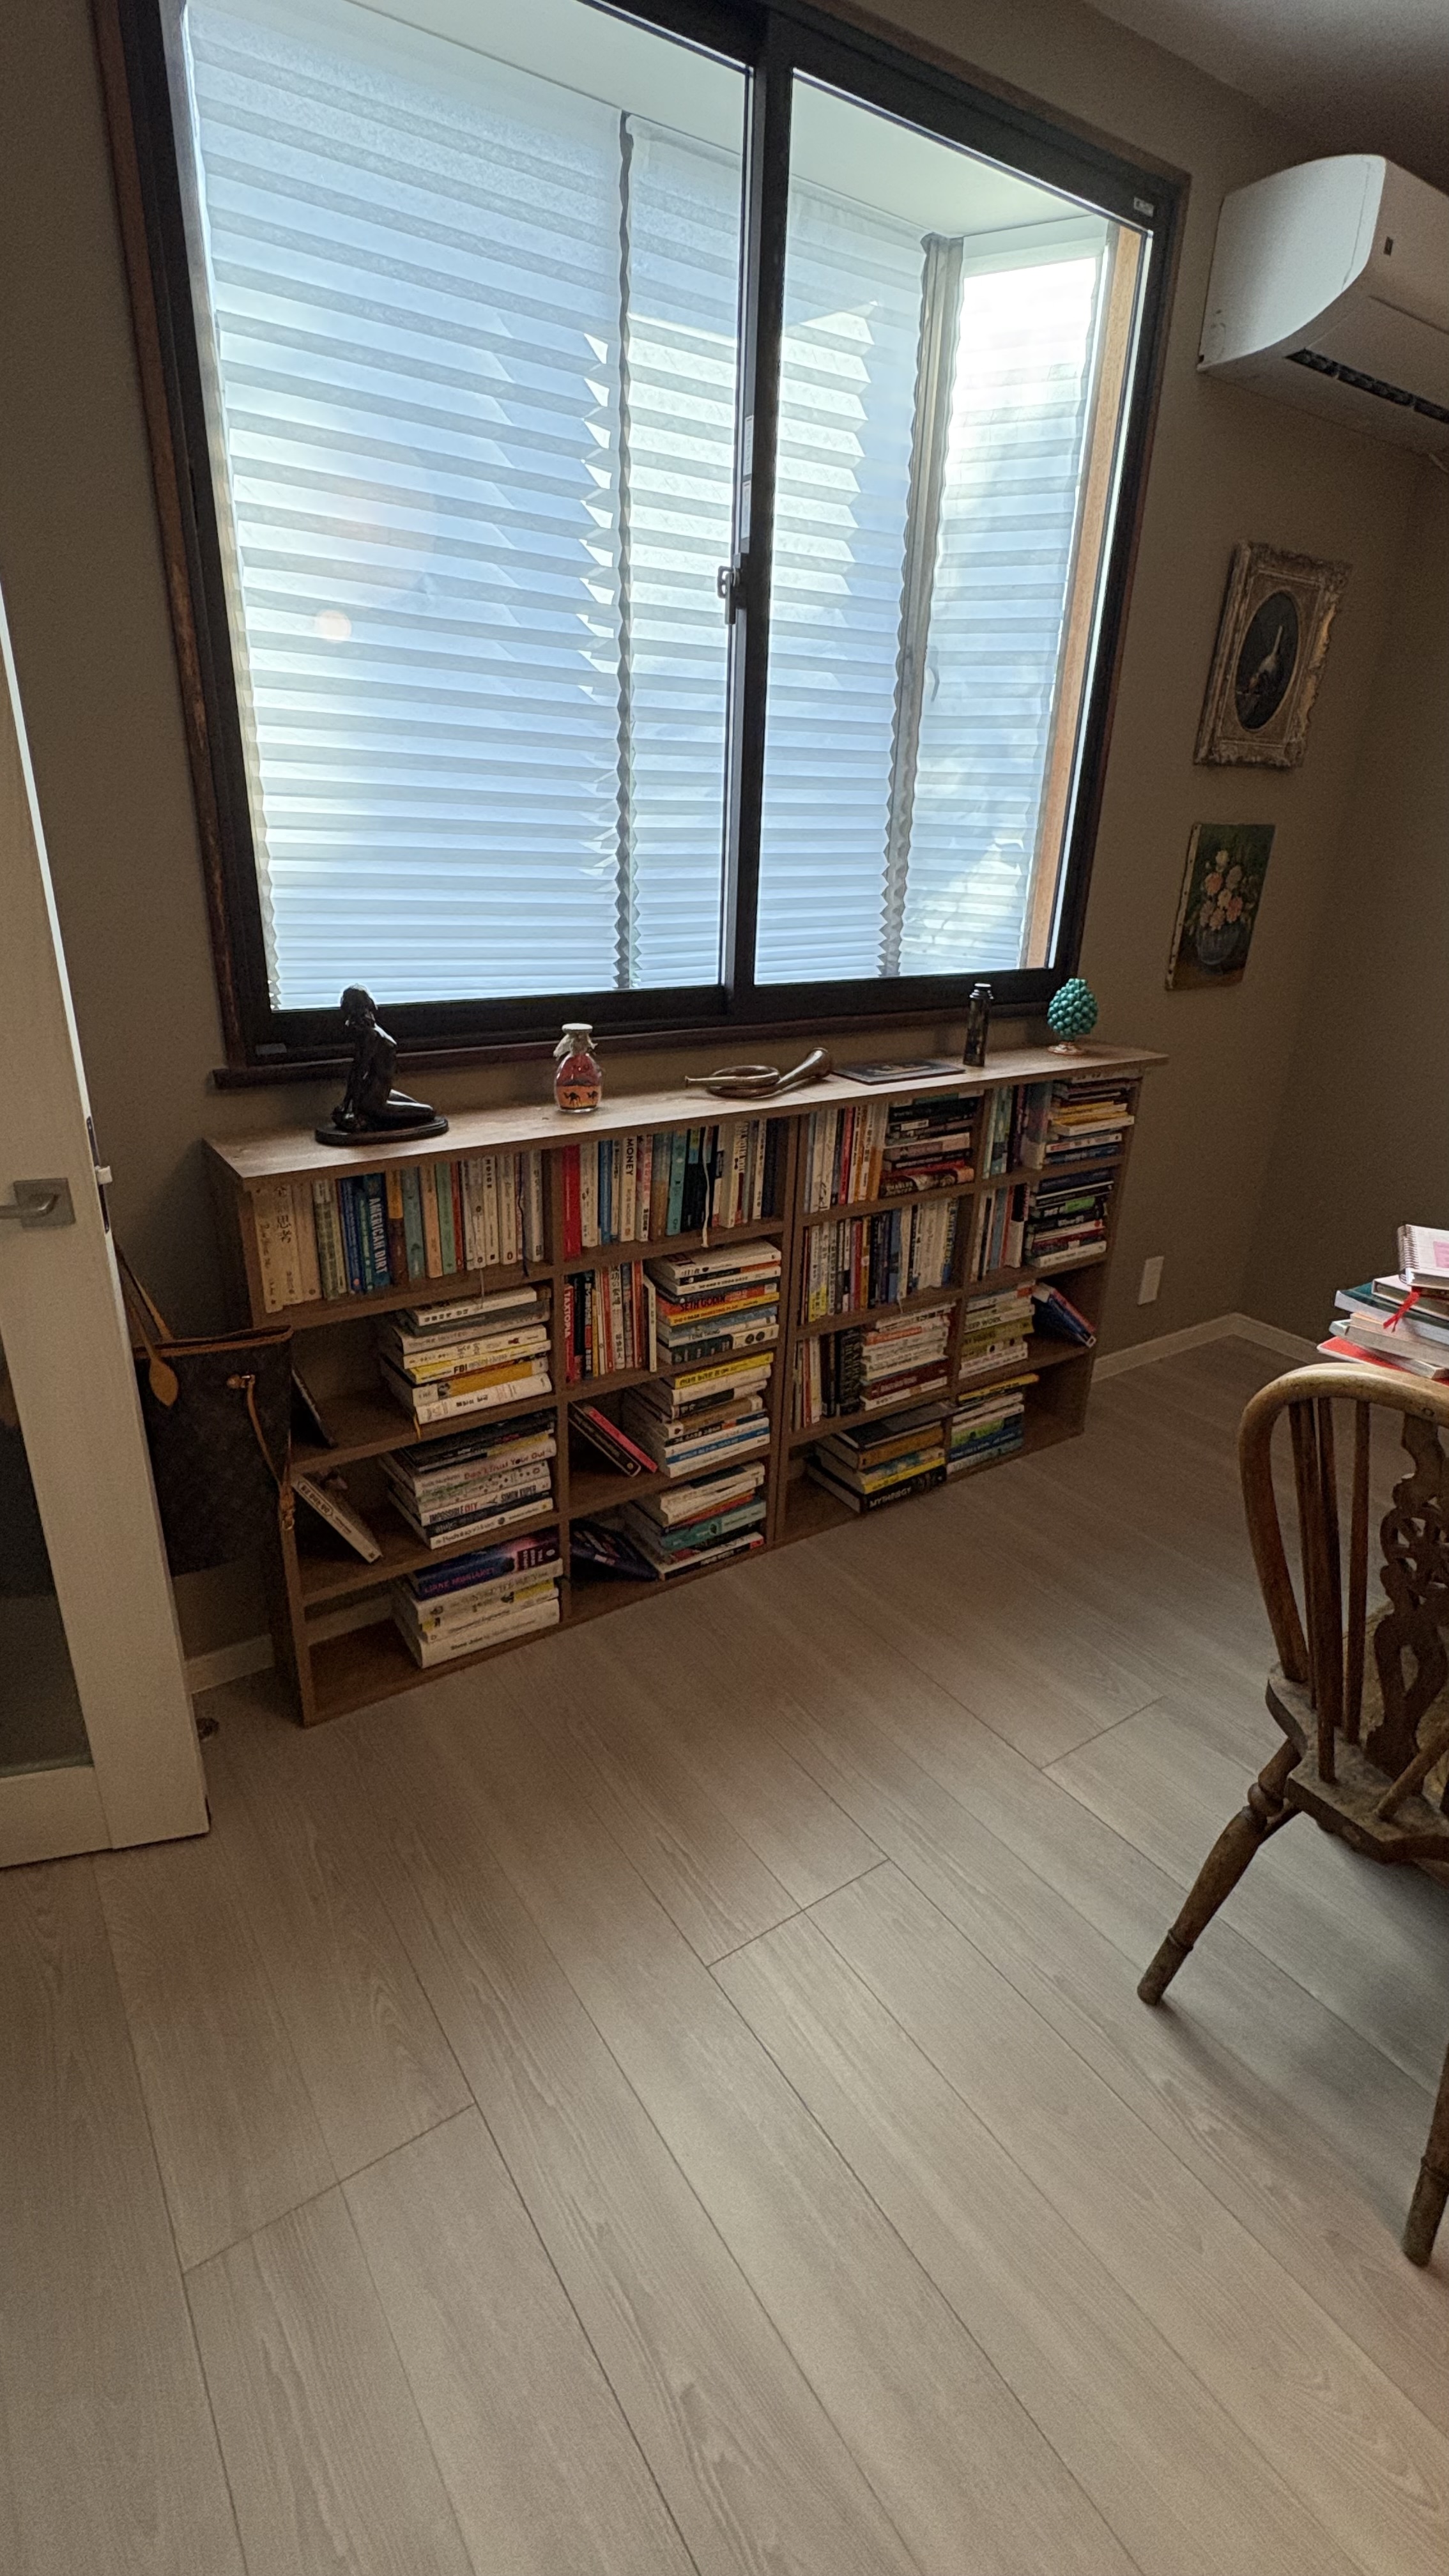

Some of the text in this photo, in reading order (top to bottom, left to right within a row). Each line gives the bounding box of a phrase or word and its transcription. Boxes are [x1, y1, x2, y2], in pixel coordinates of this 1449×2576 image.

[626, 1138, 634, 1176] MONEY
[369, 1197, 388, 1274] AMERICAN DIRT
[680, 1301, 699, 1311] SETH
[454, 1363, 468, 1374] FBI
[531, 1451, 546, 1461] Gut
